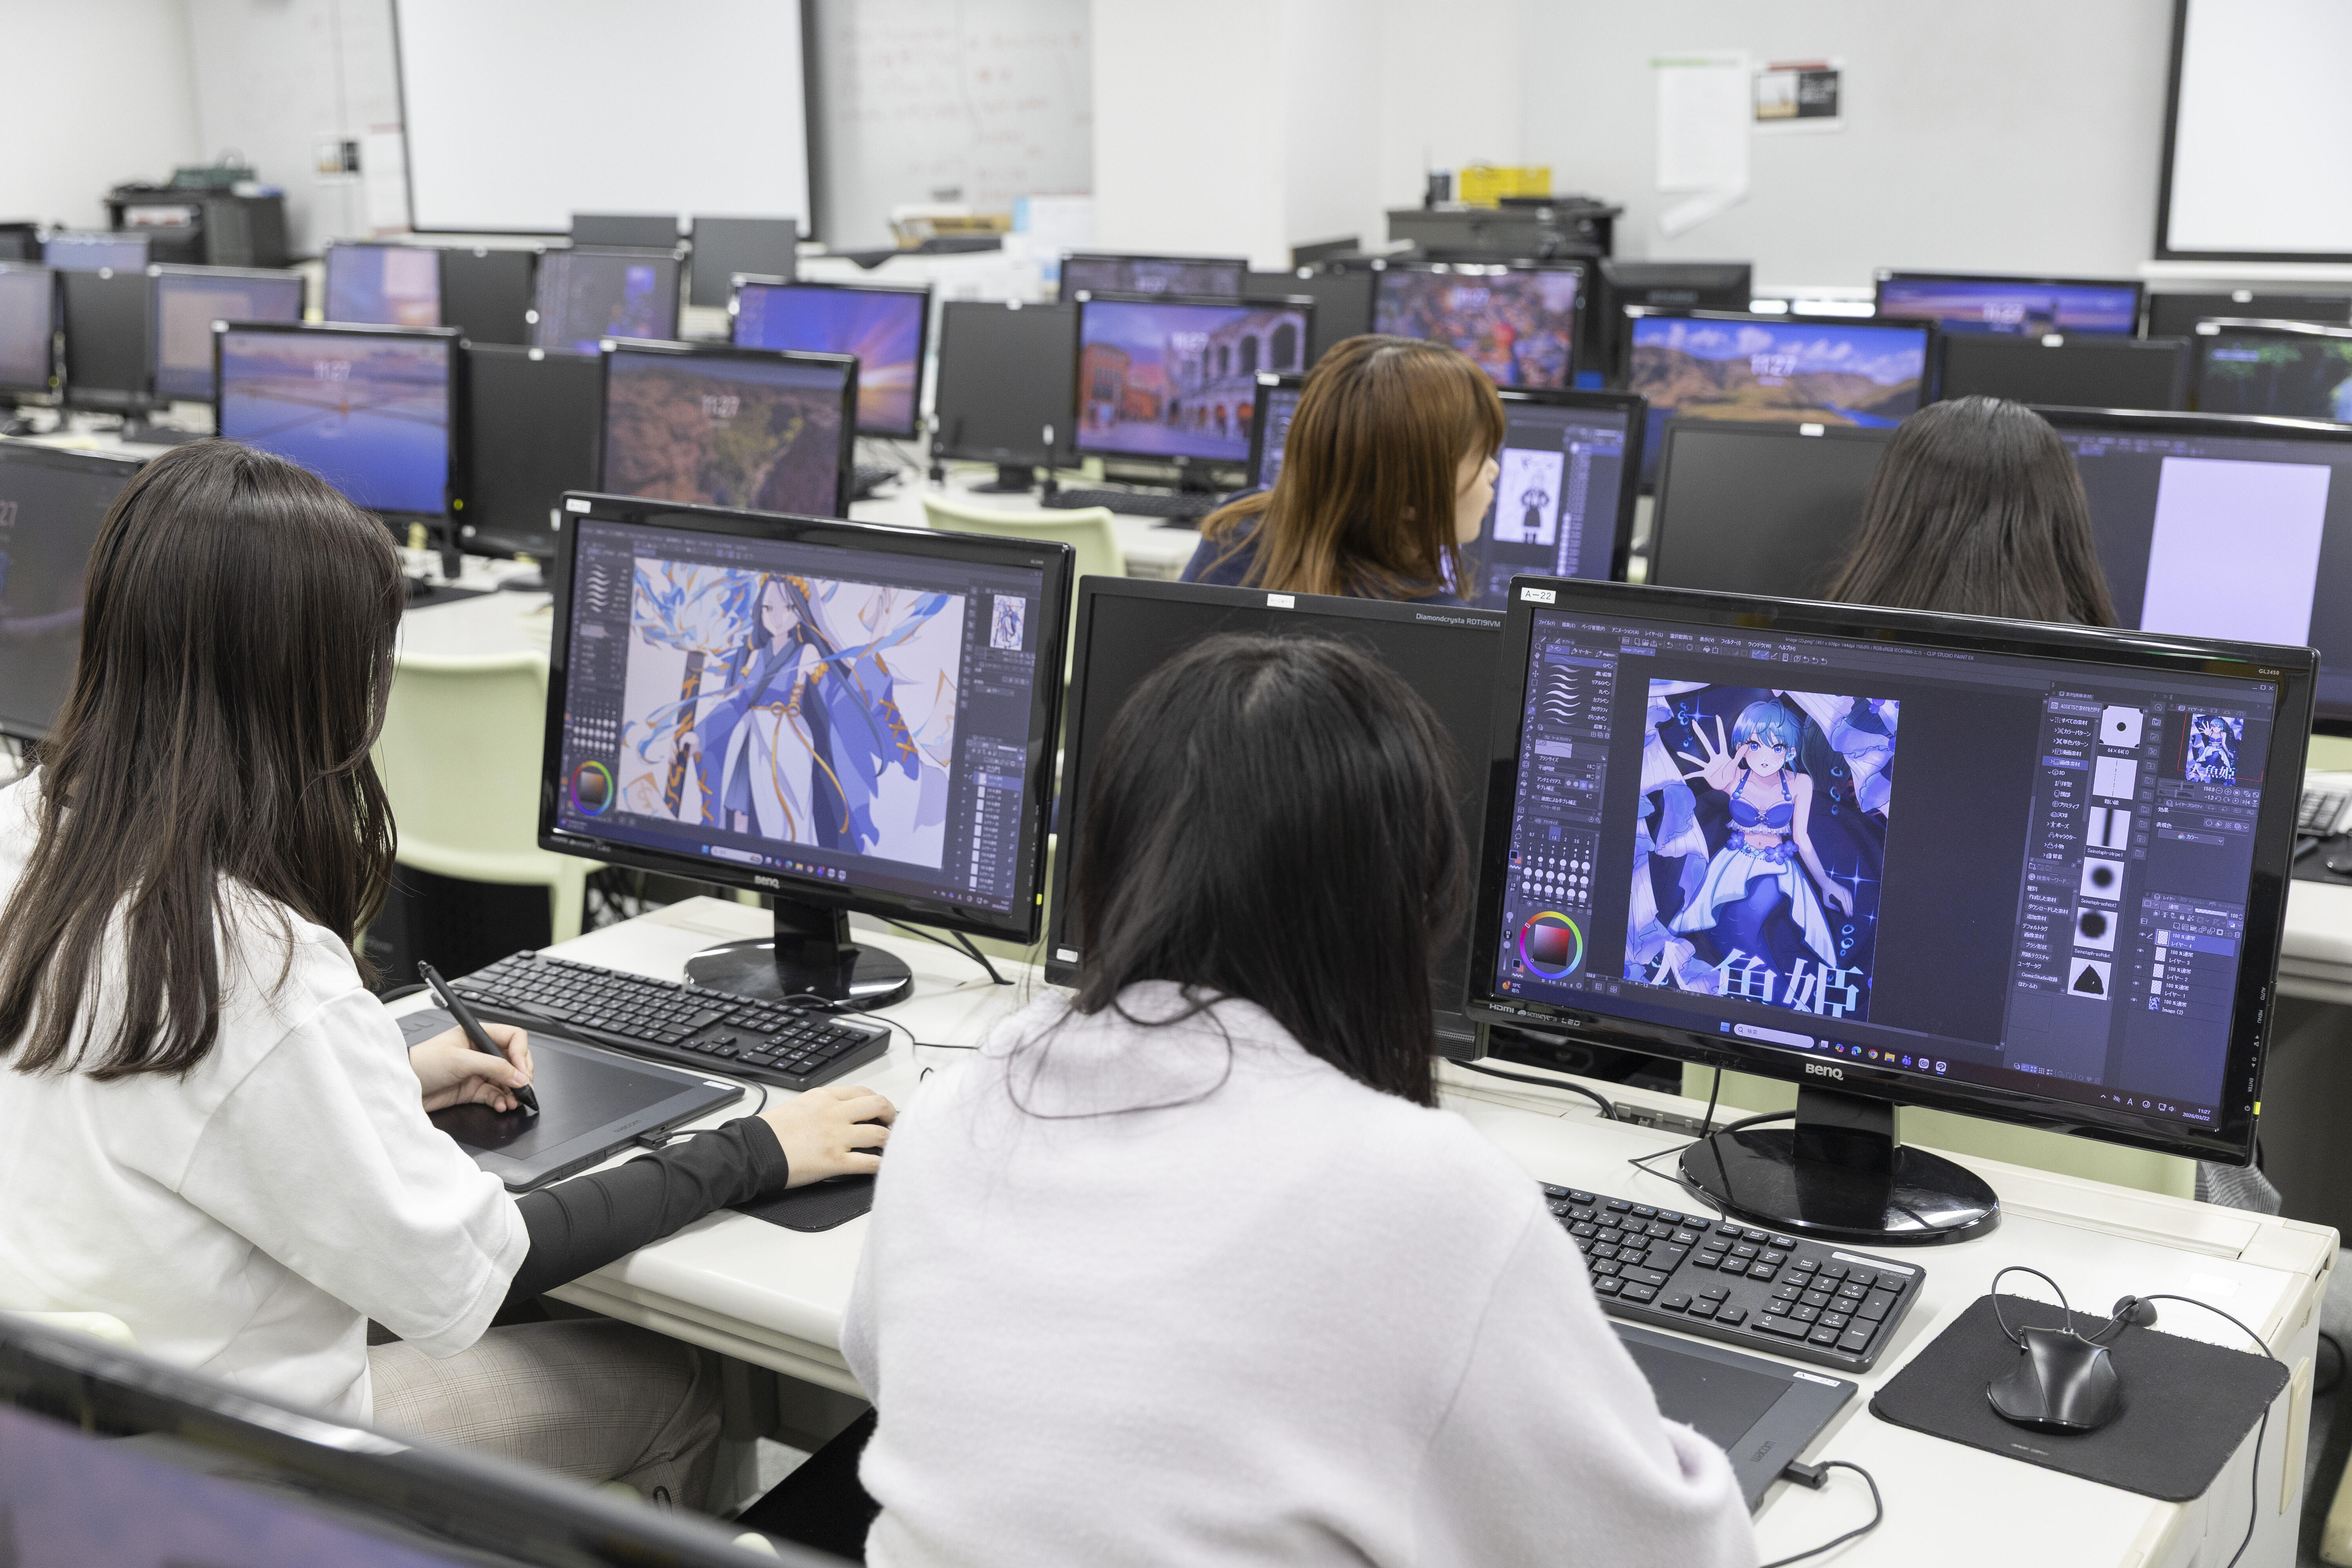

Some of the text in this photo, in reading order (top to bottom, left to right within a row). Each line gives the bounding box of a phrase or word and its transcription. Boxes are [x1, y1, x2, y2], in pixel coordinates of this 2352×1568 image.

[1416, 613, 1465, 624] Diamondcrysta
[1541, 796, 1577, 805] 速度による手ブレ補正
[2029, 894, 2056, 902] 作成した素材
[2028, 904, 2068, 915] ダウンロードした素材
[2021, 951, 2049, 960] 用紙テクスチャ
[2022, 973, 2058, 982] ComicStudio収録
[1490, 1004, 1514, 1013] HDMI
[1561, 1018, 1580, 1026] LED
[1806, 1063, 1843, 1080] BenQ
[2183, 1113, 2210, 1121] 2026/03/22
[1879, 1270, 1911, 1280] ELECOM
